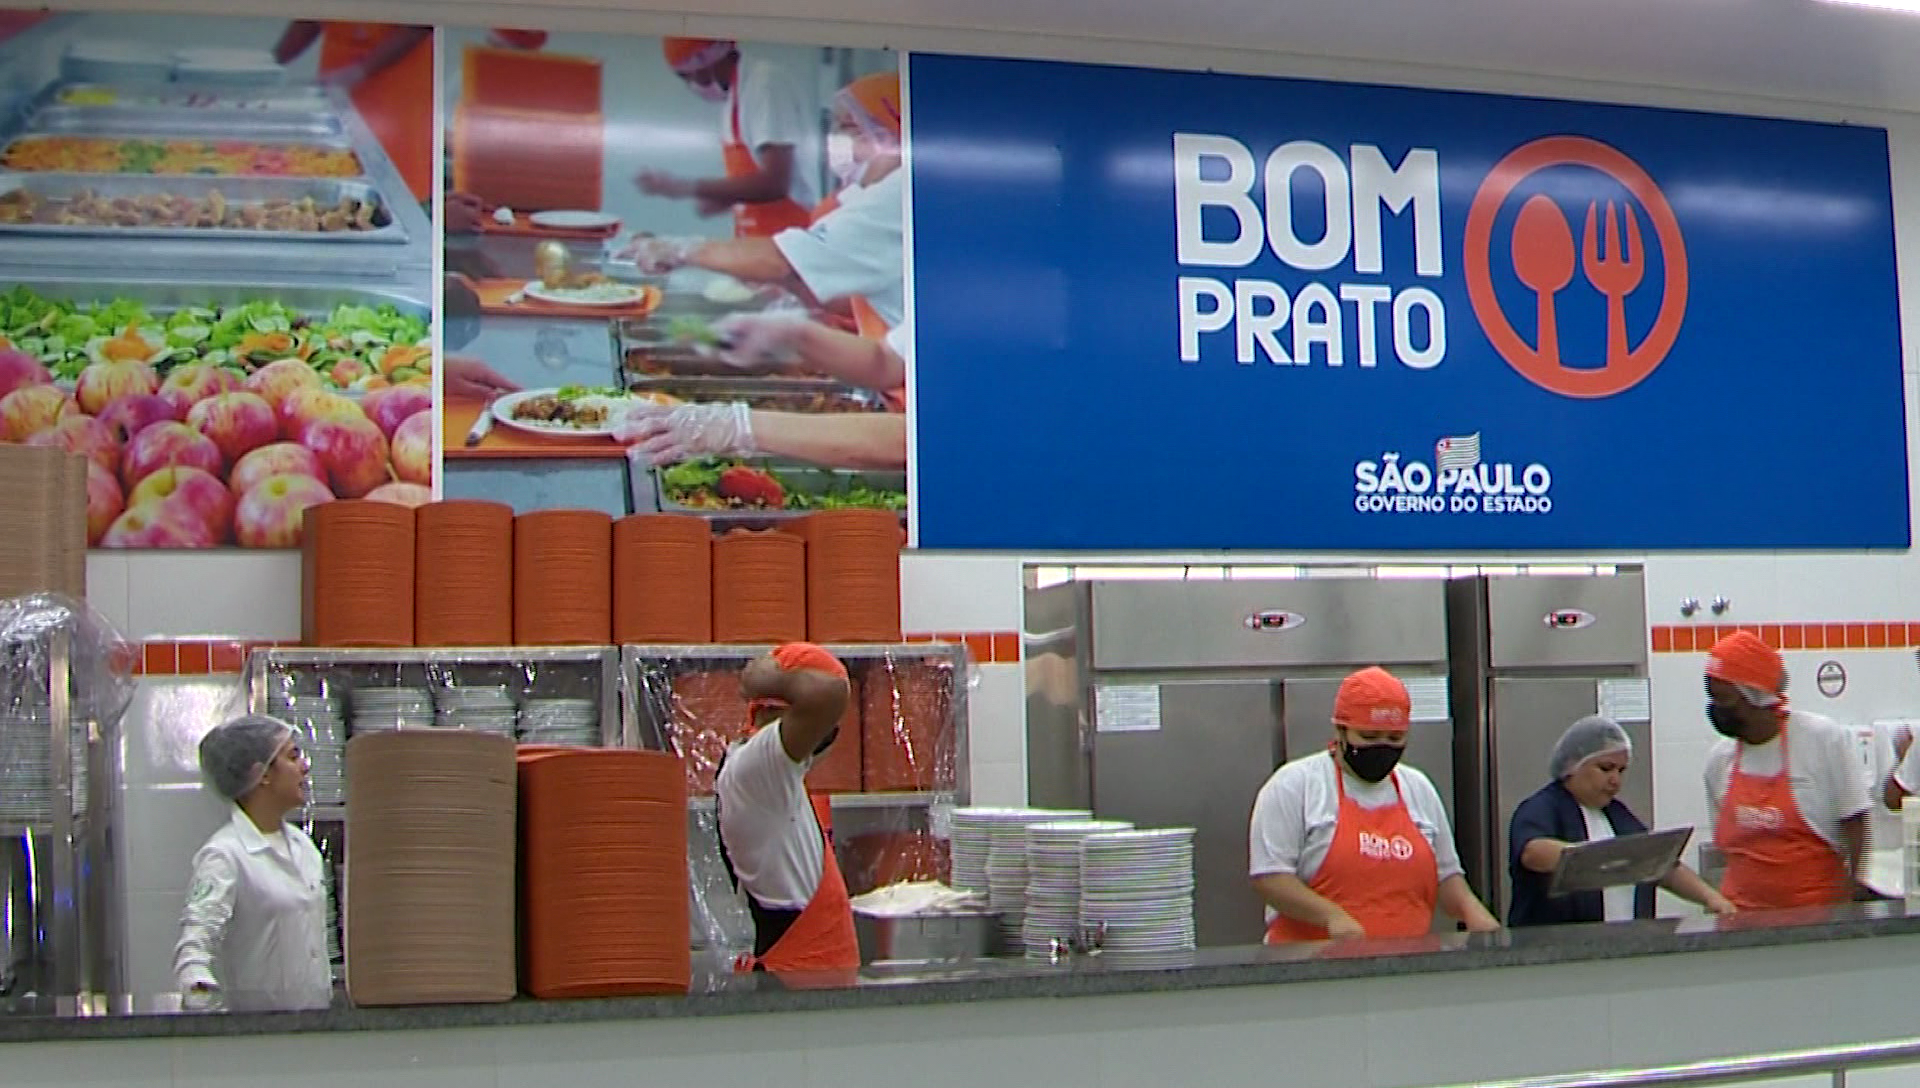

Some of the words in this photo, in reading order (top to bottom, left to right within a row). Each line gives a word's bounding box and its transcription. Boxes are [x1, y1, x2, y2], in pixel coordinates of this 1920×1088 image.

[1174, 133, 1443, 277] BOM
[1178, 276, 1446, 369] PRATO
[1355, 452, 1432, 494] SÃO
[1437, 463, 1551, 494] PAULO
[1355, 495, 1445, 512] GOVERNO
[1451, 495, 1478, 512] DO
[1483, 495, 1551, 513] ESTADO
